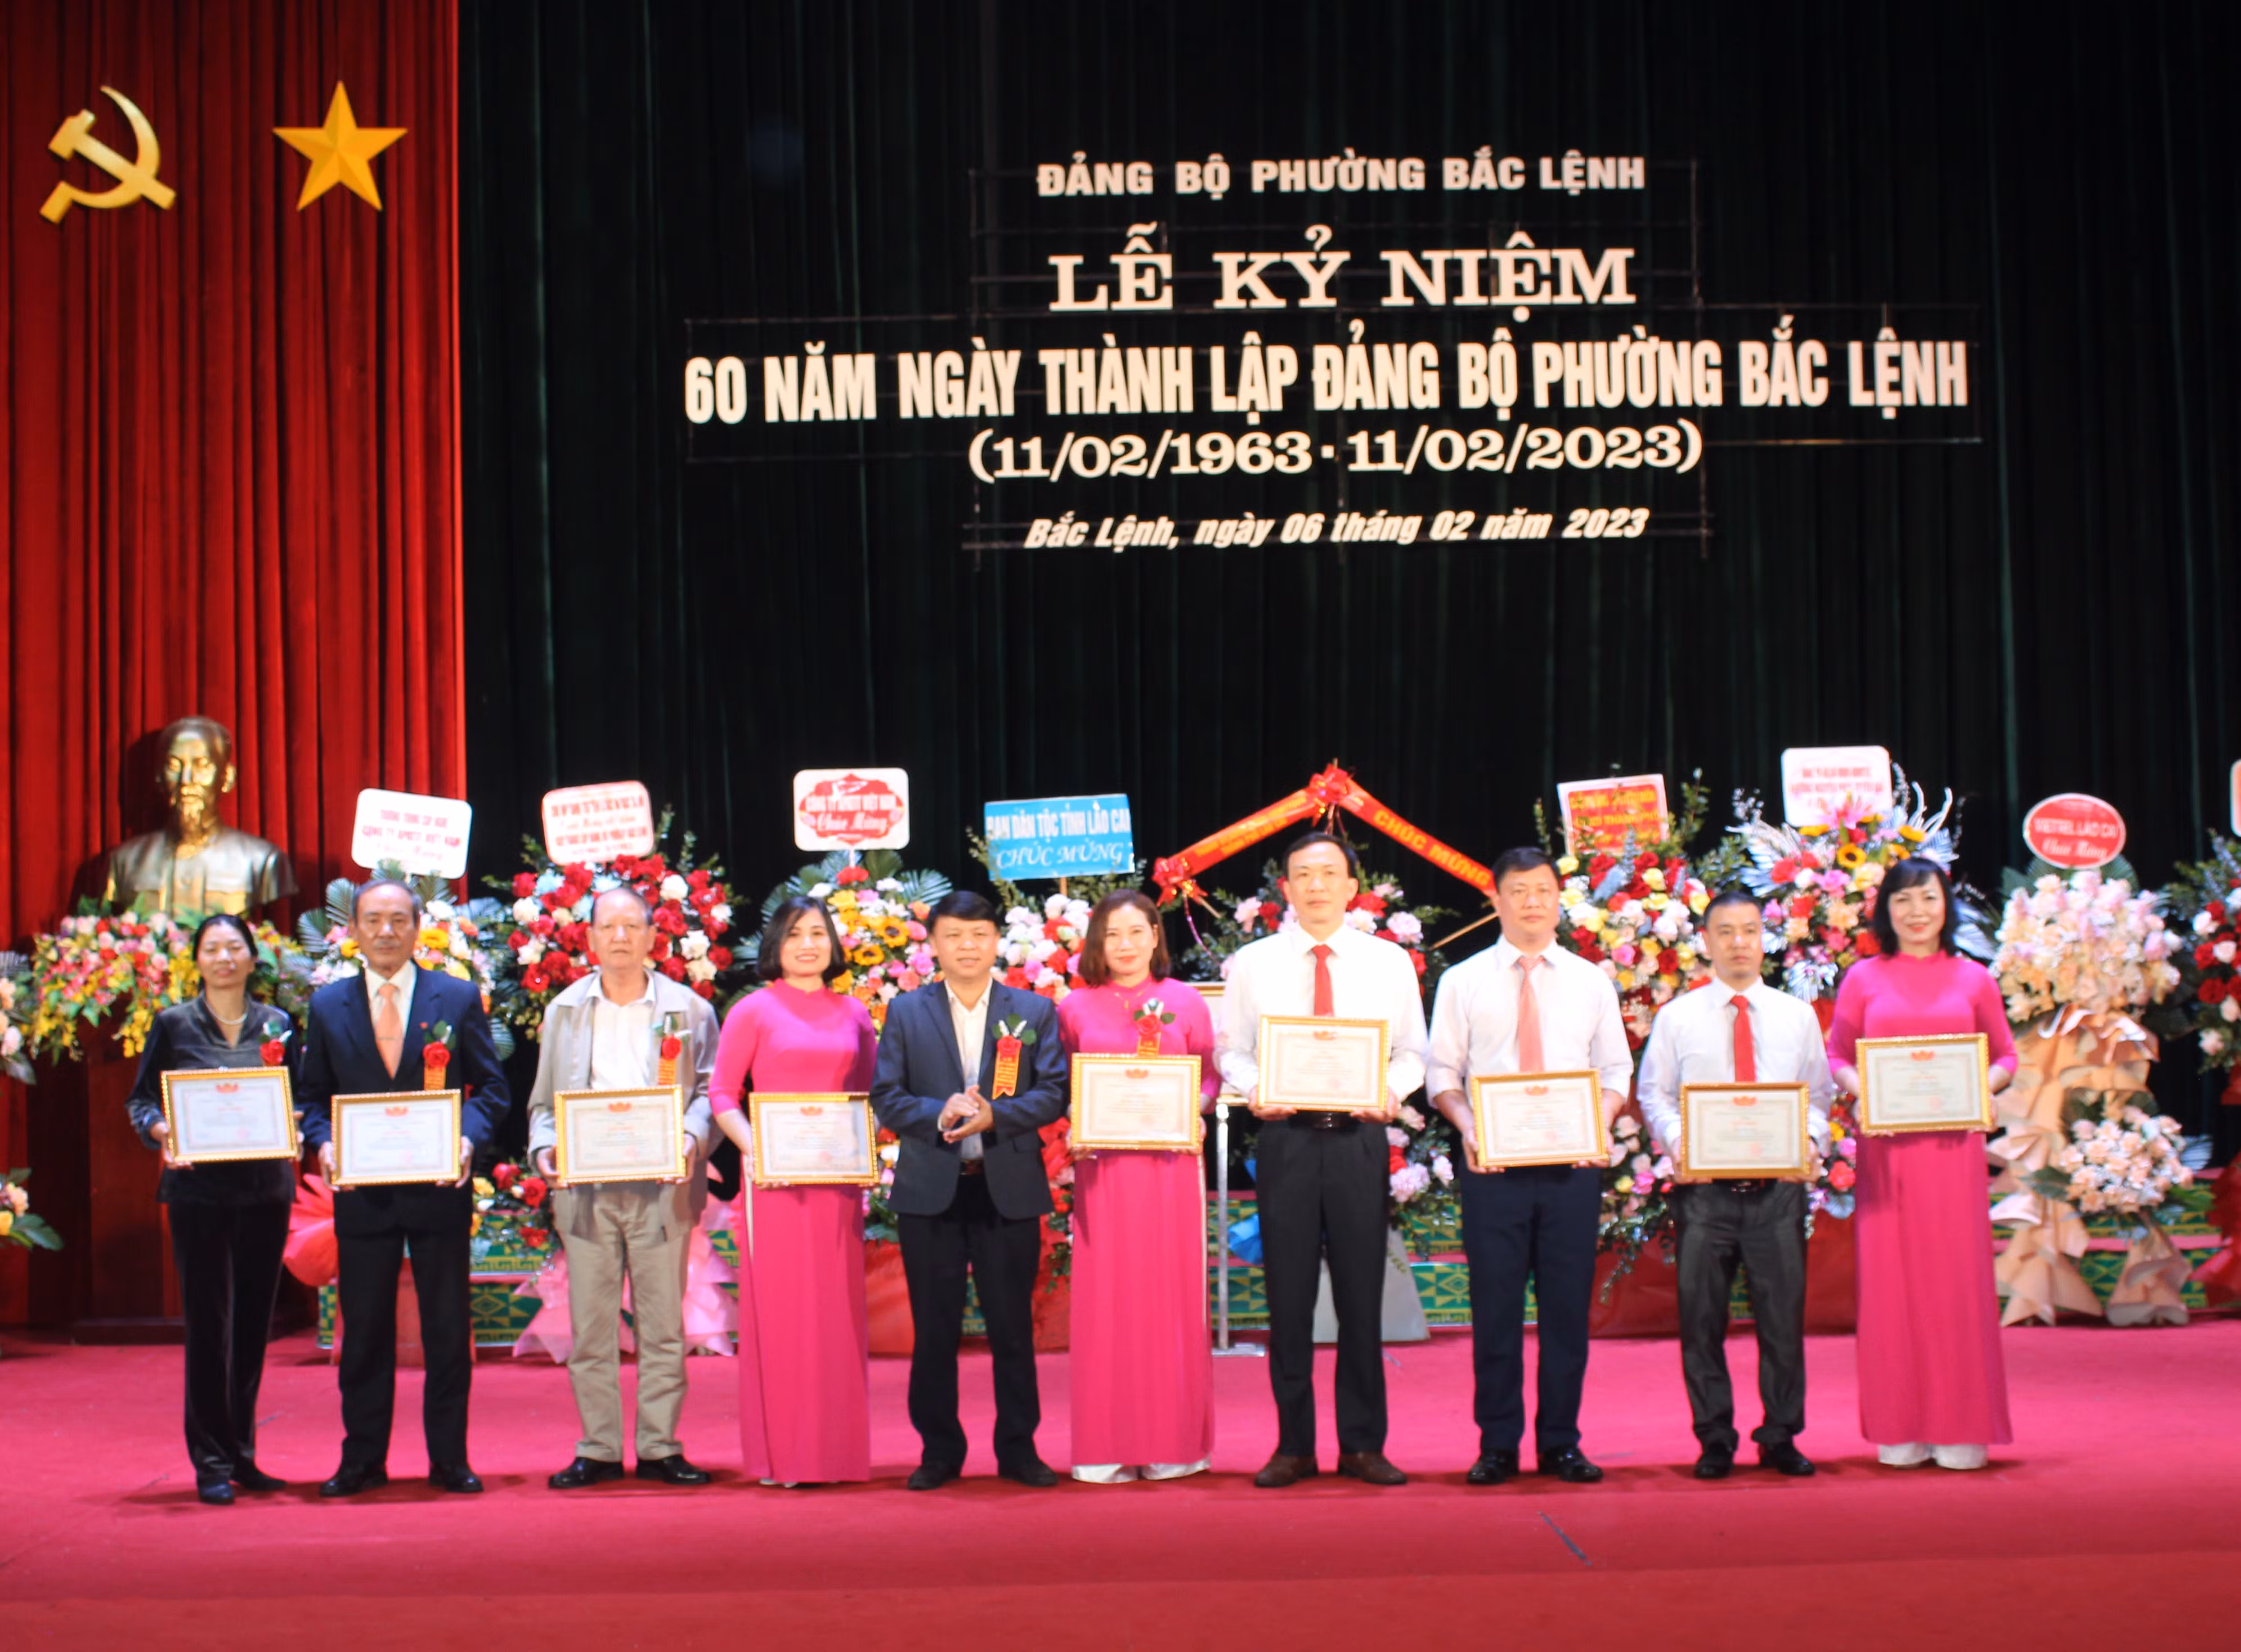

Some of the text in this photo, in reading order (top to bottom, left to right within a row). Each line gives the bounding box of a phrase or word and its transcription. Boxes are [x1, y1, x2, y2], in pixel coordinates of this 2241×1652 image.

[1037, 147, 1644, 200] ĐẢNG BỘ PHƯỜNG BẮC LỆNH
[1048, 223, 1635, 322] LỄ KỶ NIỆM
[685, 316, 1966, 425] 60 NĂM NGÀY THÀNH LẬP ĐẢNG BỘ PHƯỜNG BẮC LỆNH
[969, 429, 1312, 483] (11/02/1963
[1347, 419, 1702, 475] 11/02/2023)
[1024, 508, 1649, 553] Bắc Lệnh, ngày 06 tháng 02 năm 2023
[1012, 809, 1036, 838] DÂN
[1037, 808, 1059, 842] TỘC
[1060, 802, 1086, 836] TỈNH
[1087, 800, 1109, 834] LÀO
[1374, 809, 1491, 887] CHÚC MỪNG
[997, 837, 1124, 869] CHÚC MỪNG
